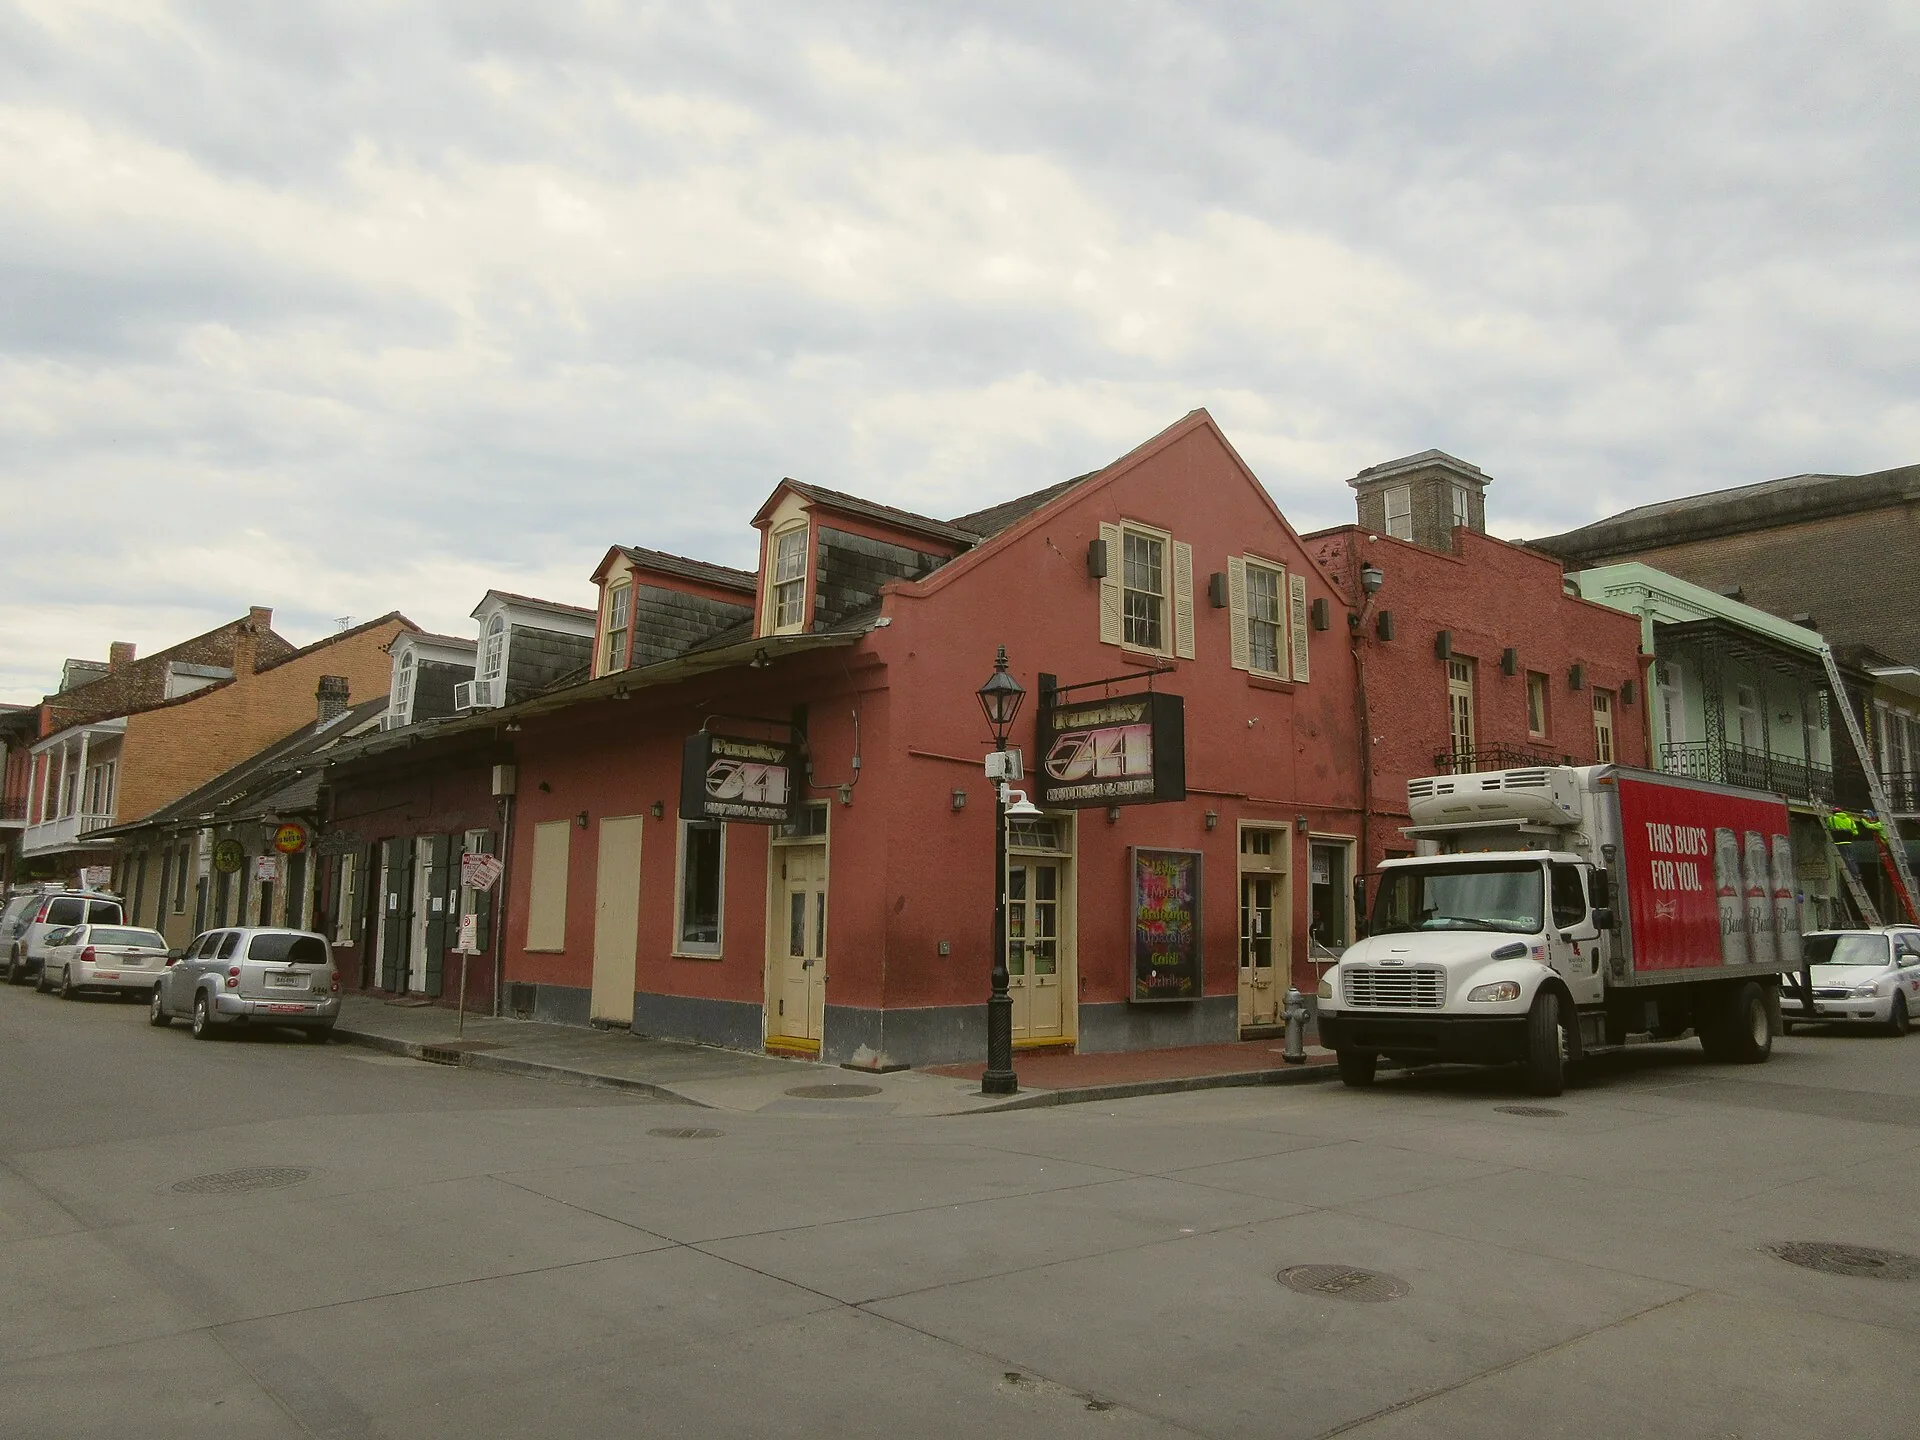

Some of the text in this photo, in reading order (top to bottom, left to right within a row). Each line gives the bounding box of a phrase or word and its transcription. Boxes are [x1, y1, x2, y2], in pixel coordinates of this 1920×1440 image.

[1045, 723, 1153, 780] 544
[706, 759, 791, 805] 544
[1646, 822, 1708, 856] THIS BUD'S
[1651, 859, 1702, 891] FOR YOU.
[1151, 886, 1185, 898] Music
[1151, 952, 1178, 966] Cold
